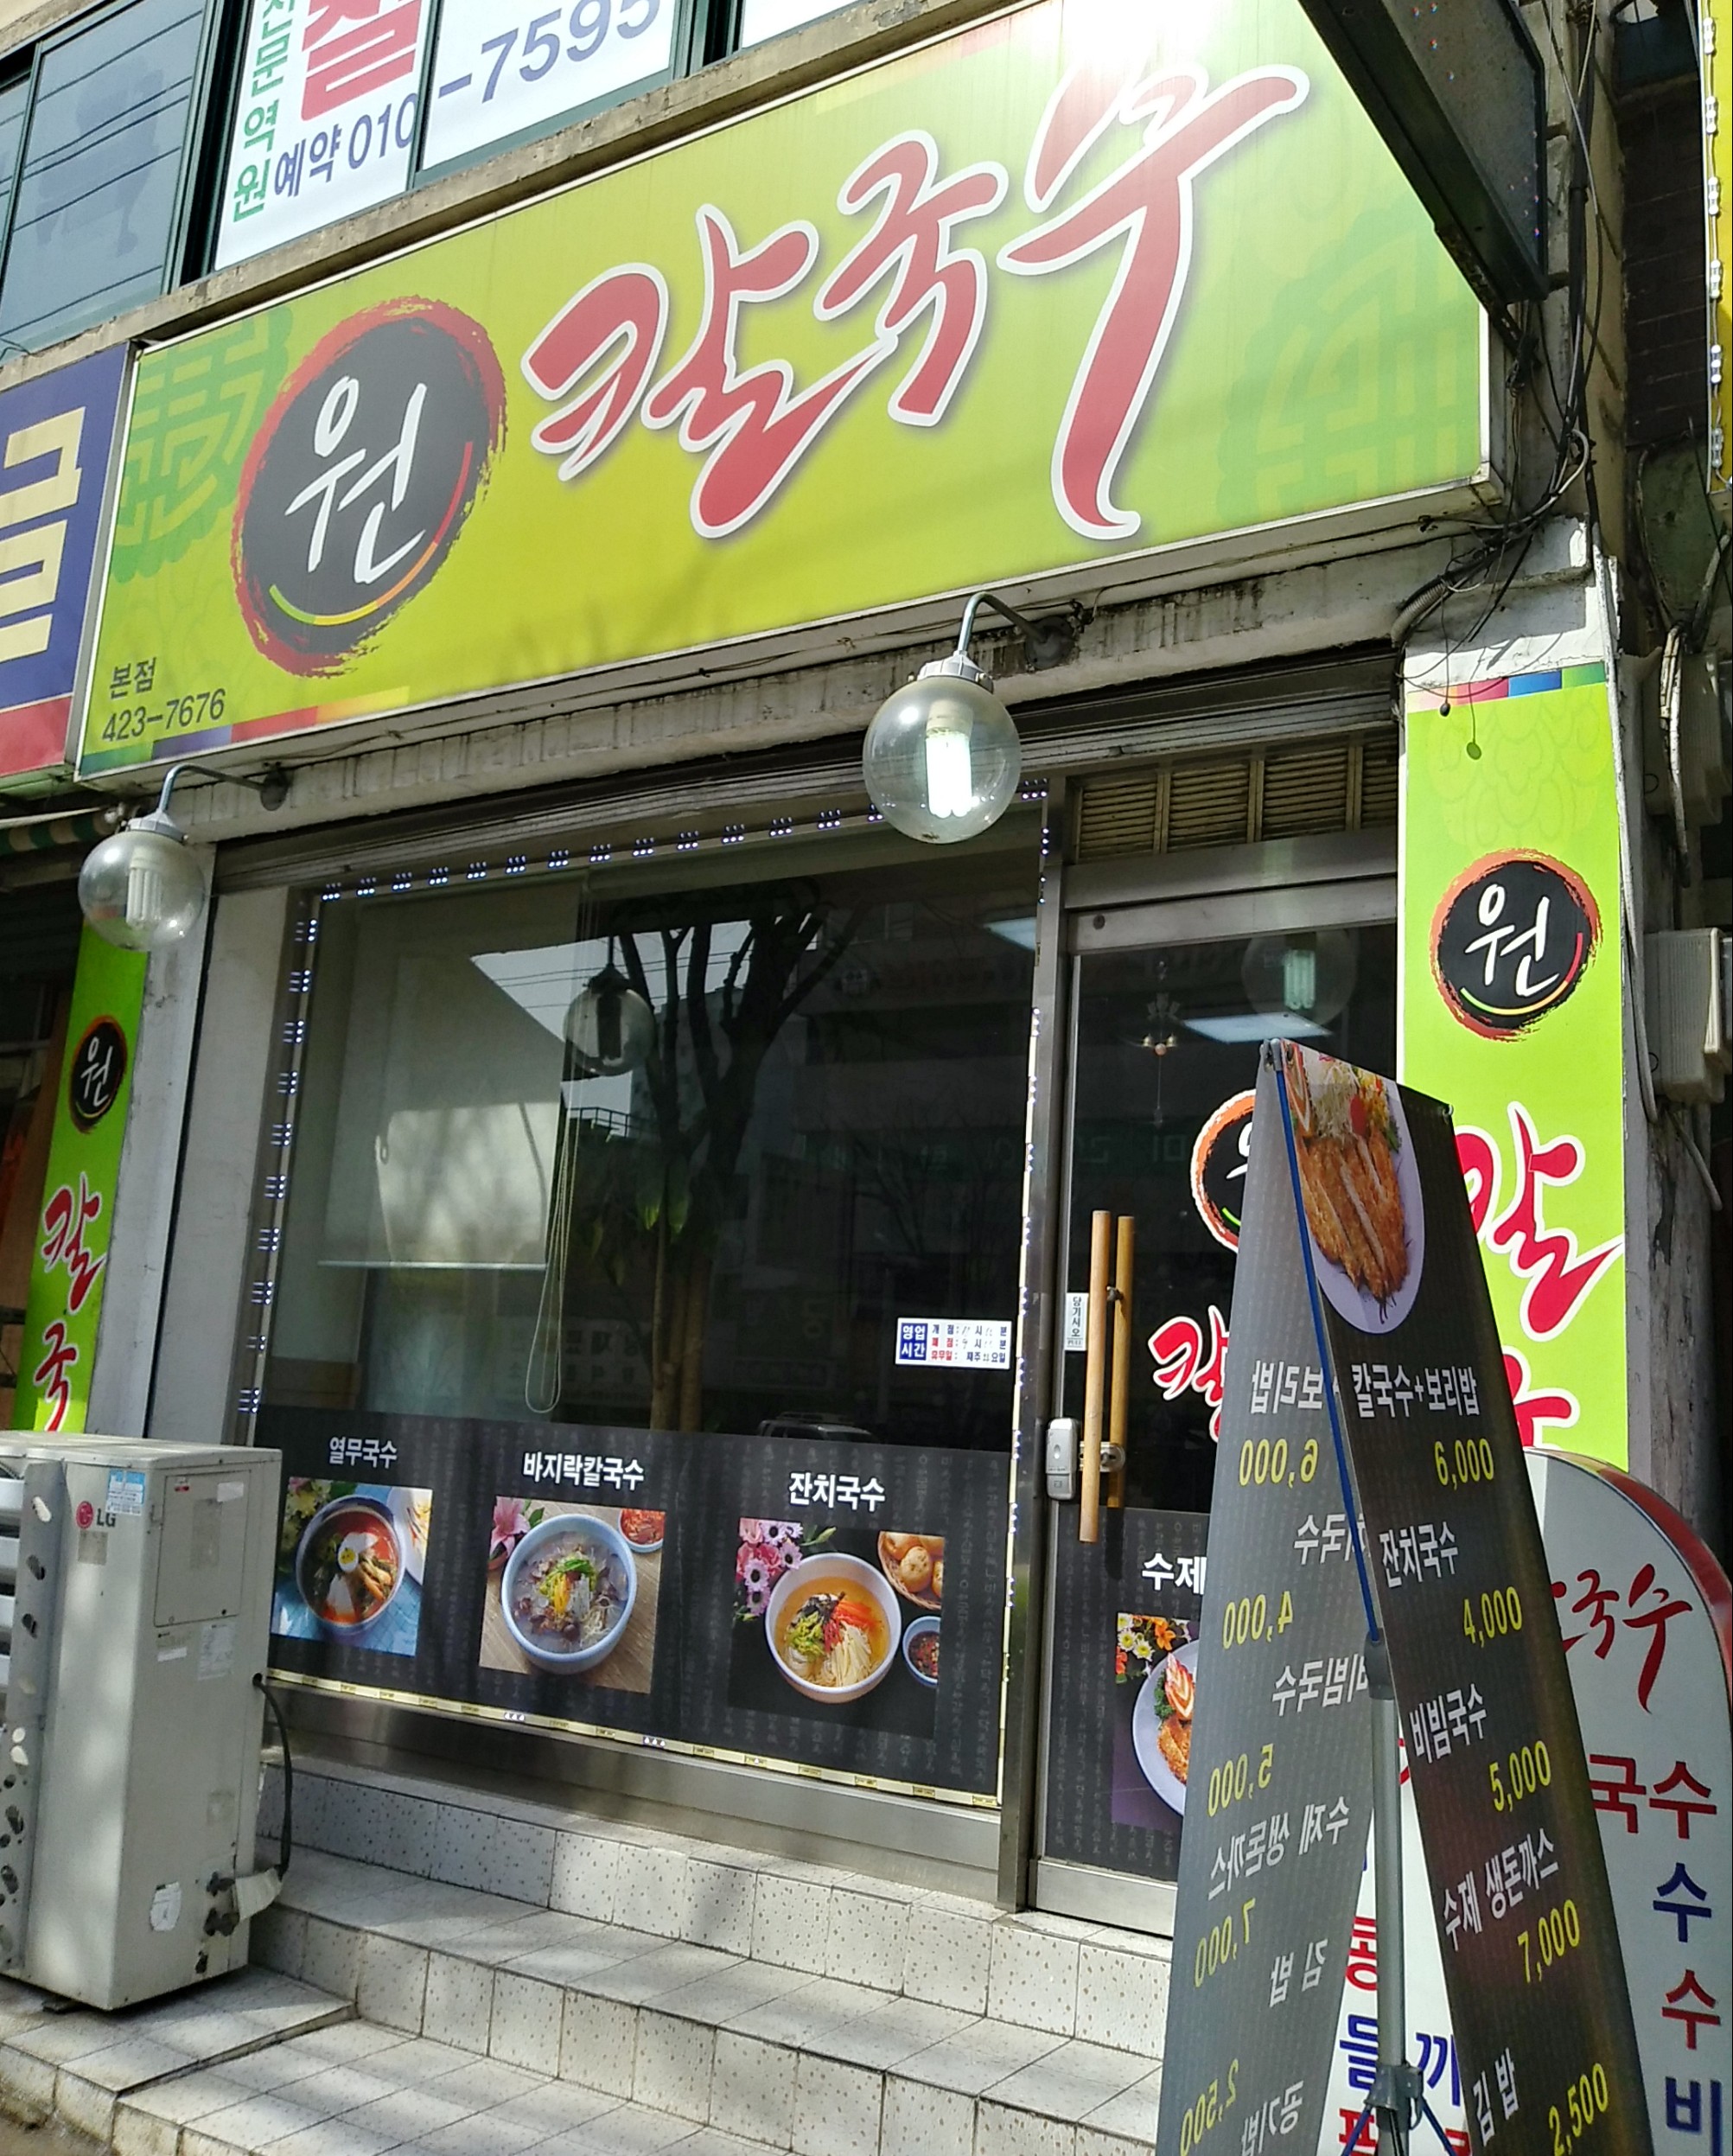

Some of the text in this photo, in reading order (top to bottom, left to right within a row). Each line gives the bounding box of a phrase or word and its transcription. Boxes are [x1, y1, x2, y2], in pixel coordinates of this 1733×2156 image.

[274, 124, 342, 197] 예약
[285, 61, 1310, 584] 원 칼국수
[110, 657, 156, 699] 본점
[102, 688, 226, 742] 423-7676
[1465, 883, 1560, 997] 원
[81, 1037, 113, 1107] 원
[902, 1325, 926, 1341] 영업
[1071, 1296, 1082, 1337] 당기시오
[902, 1343, 925, 1358] 시간
[1351, 1362, 1481, 1419] 칼국수+보리밥
[328, 1435, 398, 1469] 열무국수
[522, 1451, 646, 1491] 바지락칼국수
[1434, 1438, 1495, 1491] 6,000
[96, 1508, 117, 1528] LG
[788, 1470, 886, 1512] 잔치국수
[1142, 1553, 1207, 1595] 수제
[1379, 1521, 1459, 1589] 잔치국수
[1462, 1585, 1523, 1648] 4,000
[1551, 1563, 1692, 1714] 국수
[1409, 1683, 1488, 1764] 비빔국수
[1489, 1740, 1552, 1813] 5,000
[1443, 1827, 1559, 1952] 수제 생돈까스
[1517, 1899, 1580, 1983] 7,000
[1549, 2062, 1609, 2156] 2,500
